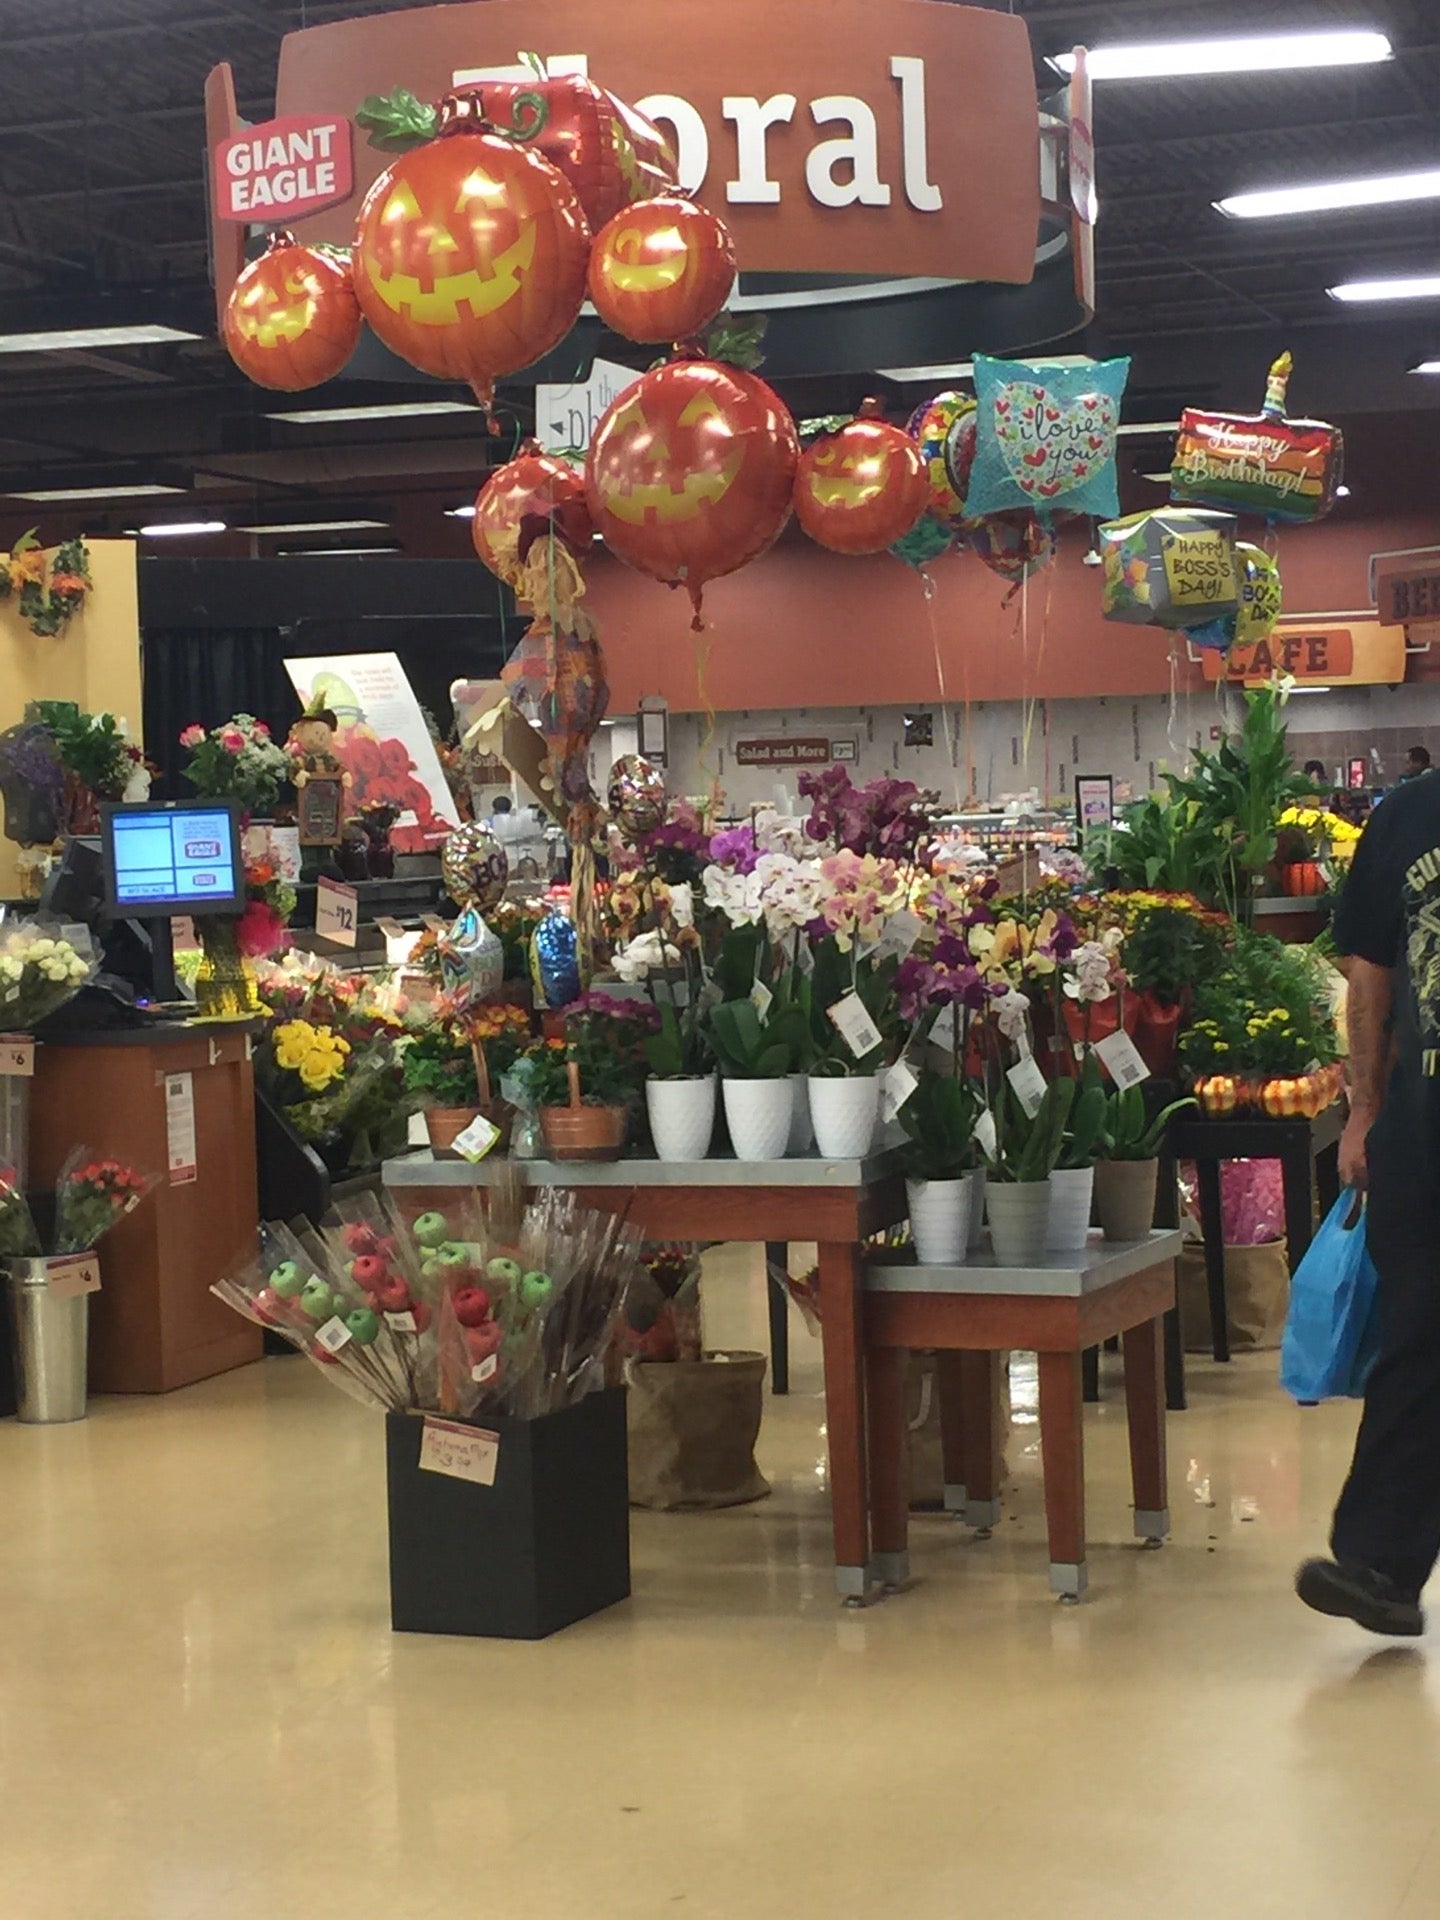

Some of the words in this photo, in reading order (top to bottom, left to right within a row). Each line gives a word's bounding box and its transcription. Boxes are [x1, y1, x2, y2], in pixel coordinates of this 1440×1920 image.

[226, 124, 336, 176] GIANT
[231, 162, 336, 212] EAGLE
[1032, 403, 1097, 440] love
[1208, 421, 1291, 463] Happy
[1045, 446, 1098, 485] you
[1184, 450, 1307, 499] Birthday!
[1178, 539, 1225, 557] HAPPY
[1177, 578, 1223, 600] DAY!
[740, 746, 770, 760] Salad
[773, 745, 794, 758] and
[797, 744, 826, 758] More
